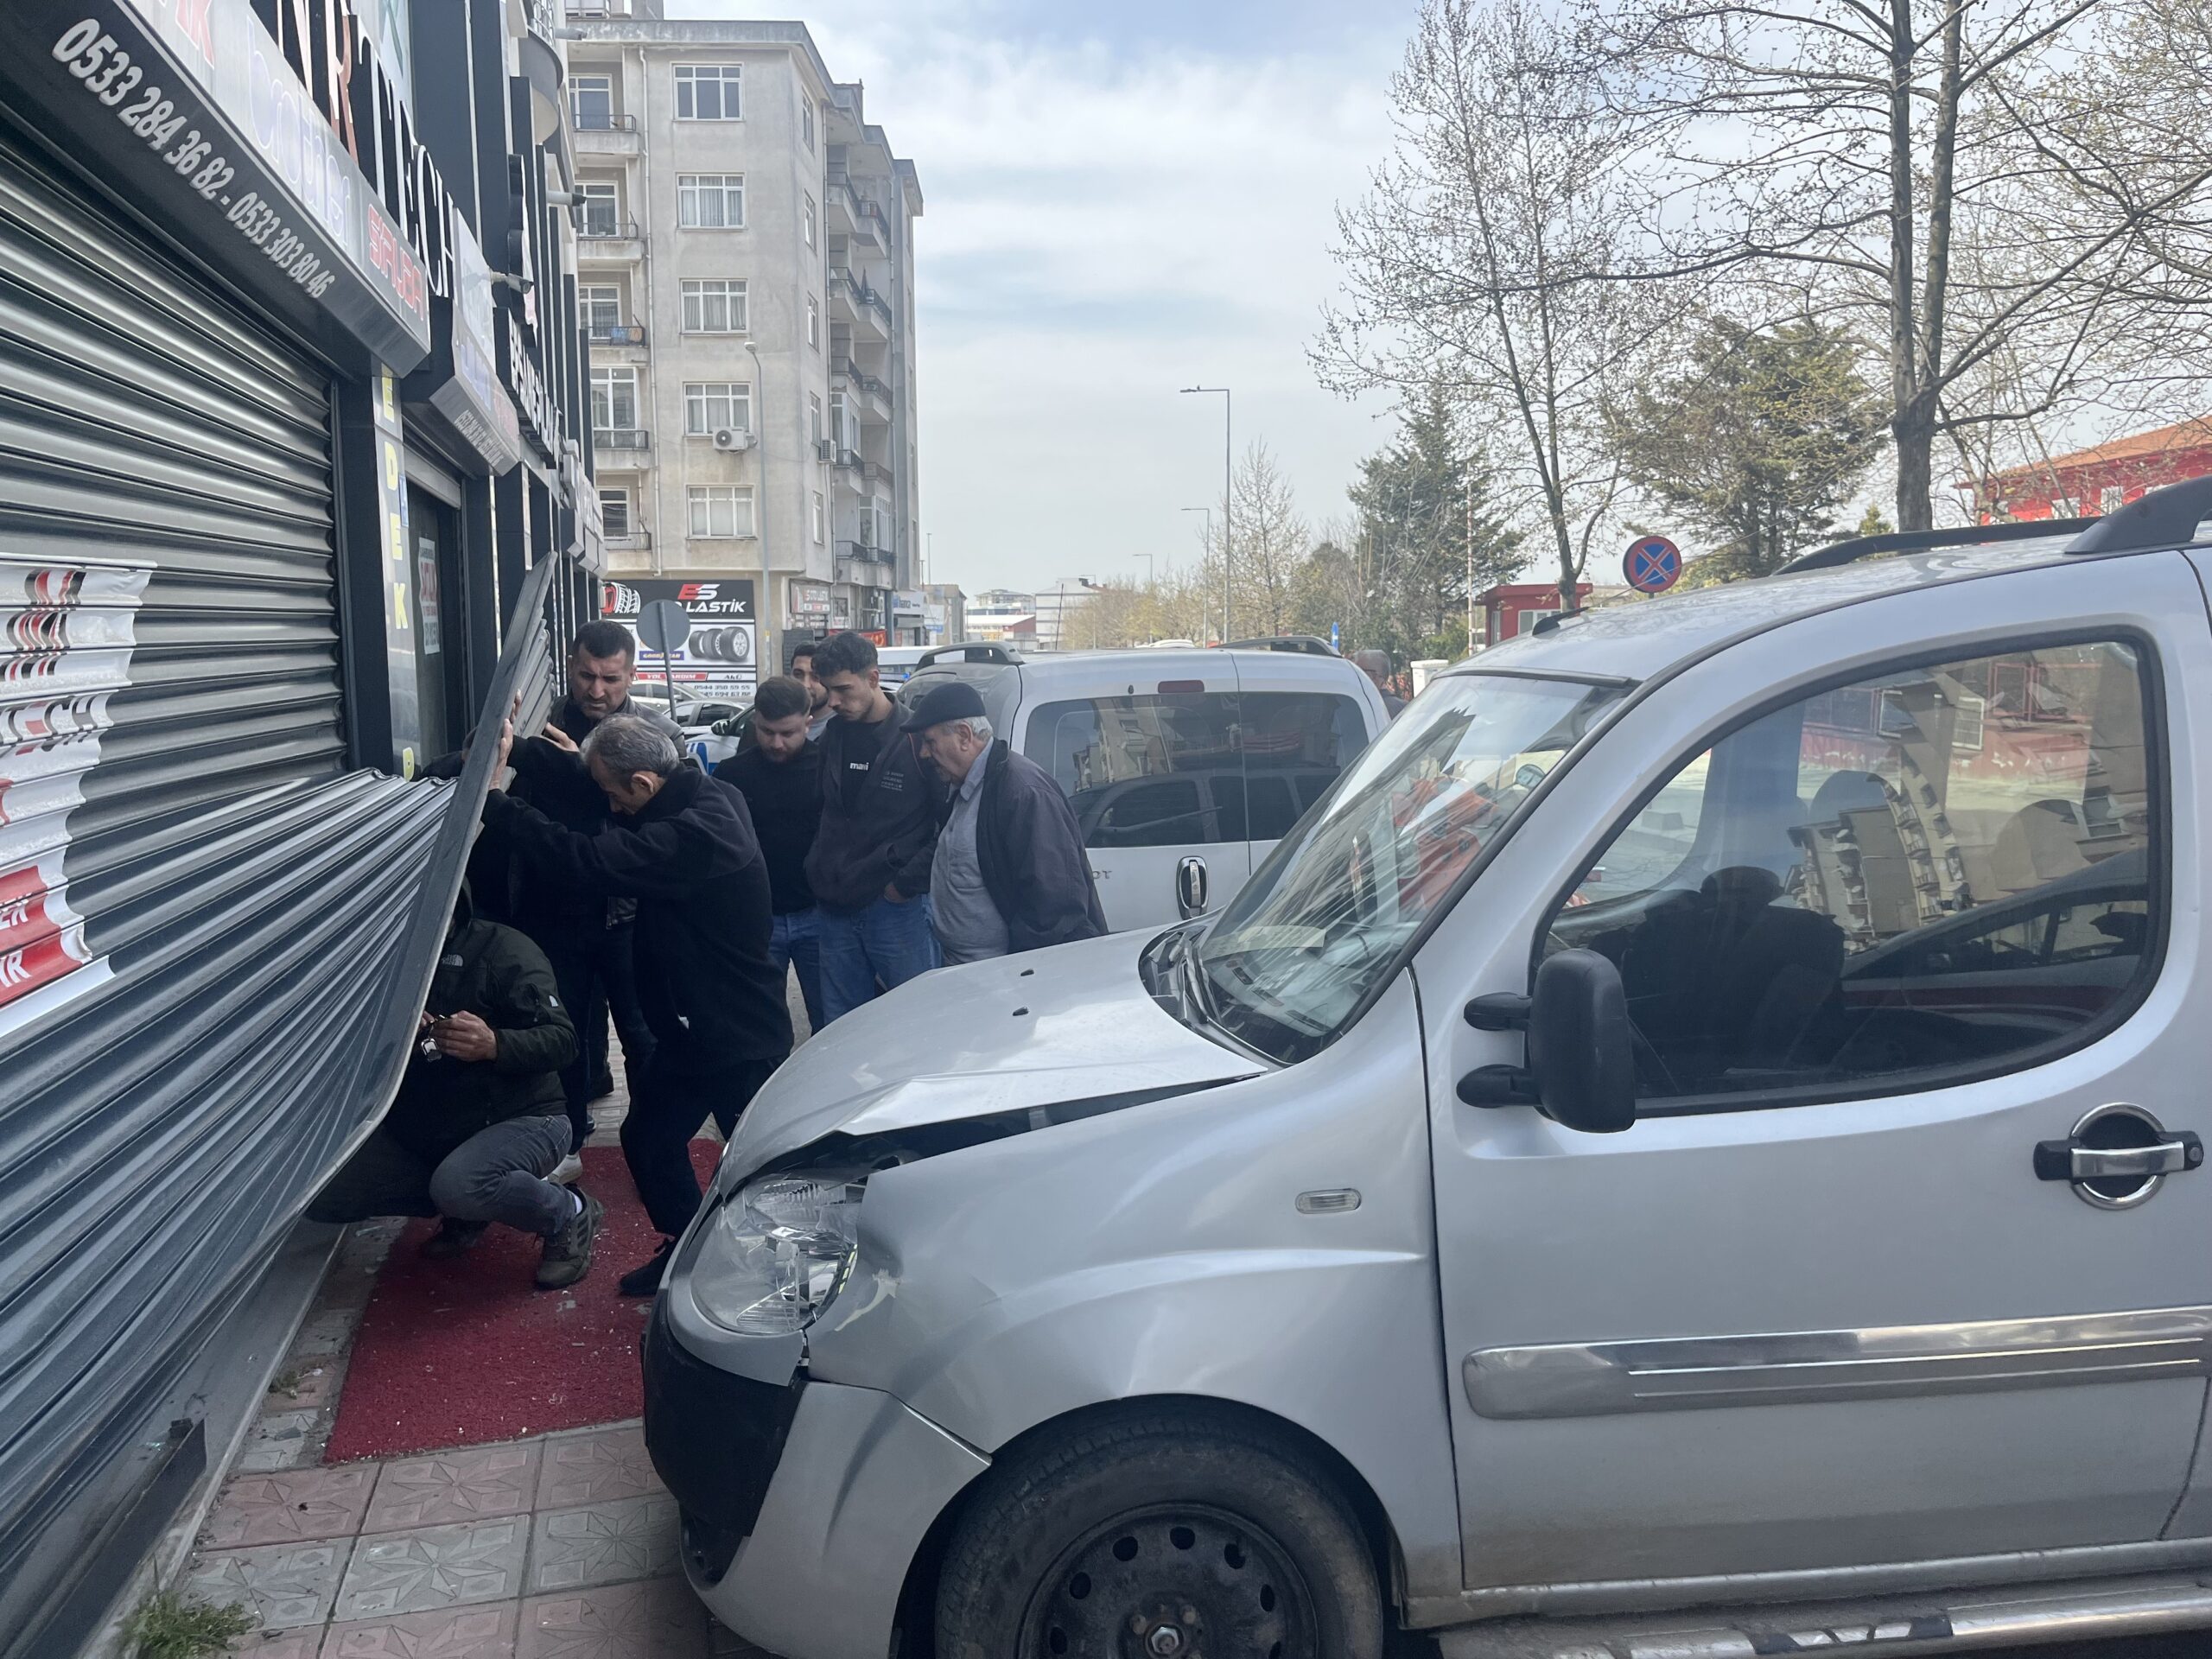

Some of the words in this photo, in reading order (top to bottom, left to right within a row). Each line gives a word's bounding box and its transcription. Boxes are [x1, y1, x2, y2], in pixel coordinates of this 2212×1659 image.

[52, 18, 143, 105] 0533
[117, 86, 188, 150] 284
[162, 130, 212, 175] 36
[189, 157, 235, 200] 82
[226, 192, 281, 245] 0533
[261, 228, 305, 268] 303
[286, 252, 321, 283] 80
[304, 270, 335, 298] 46
[685, 598, 747, 613] LASTİK
